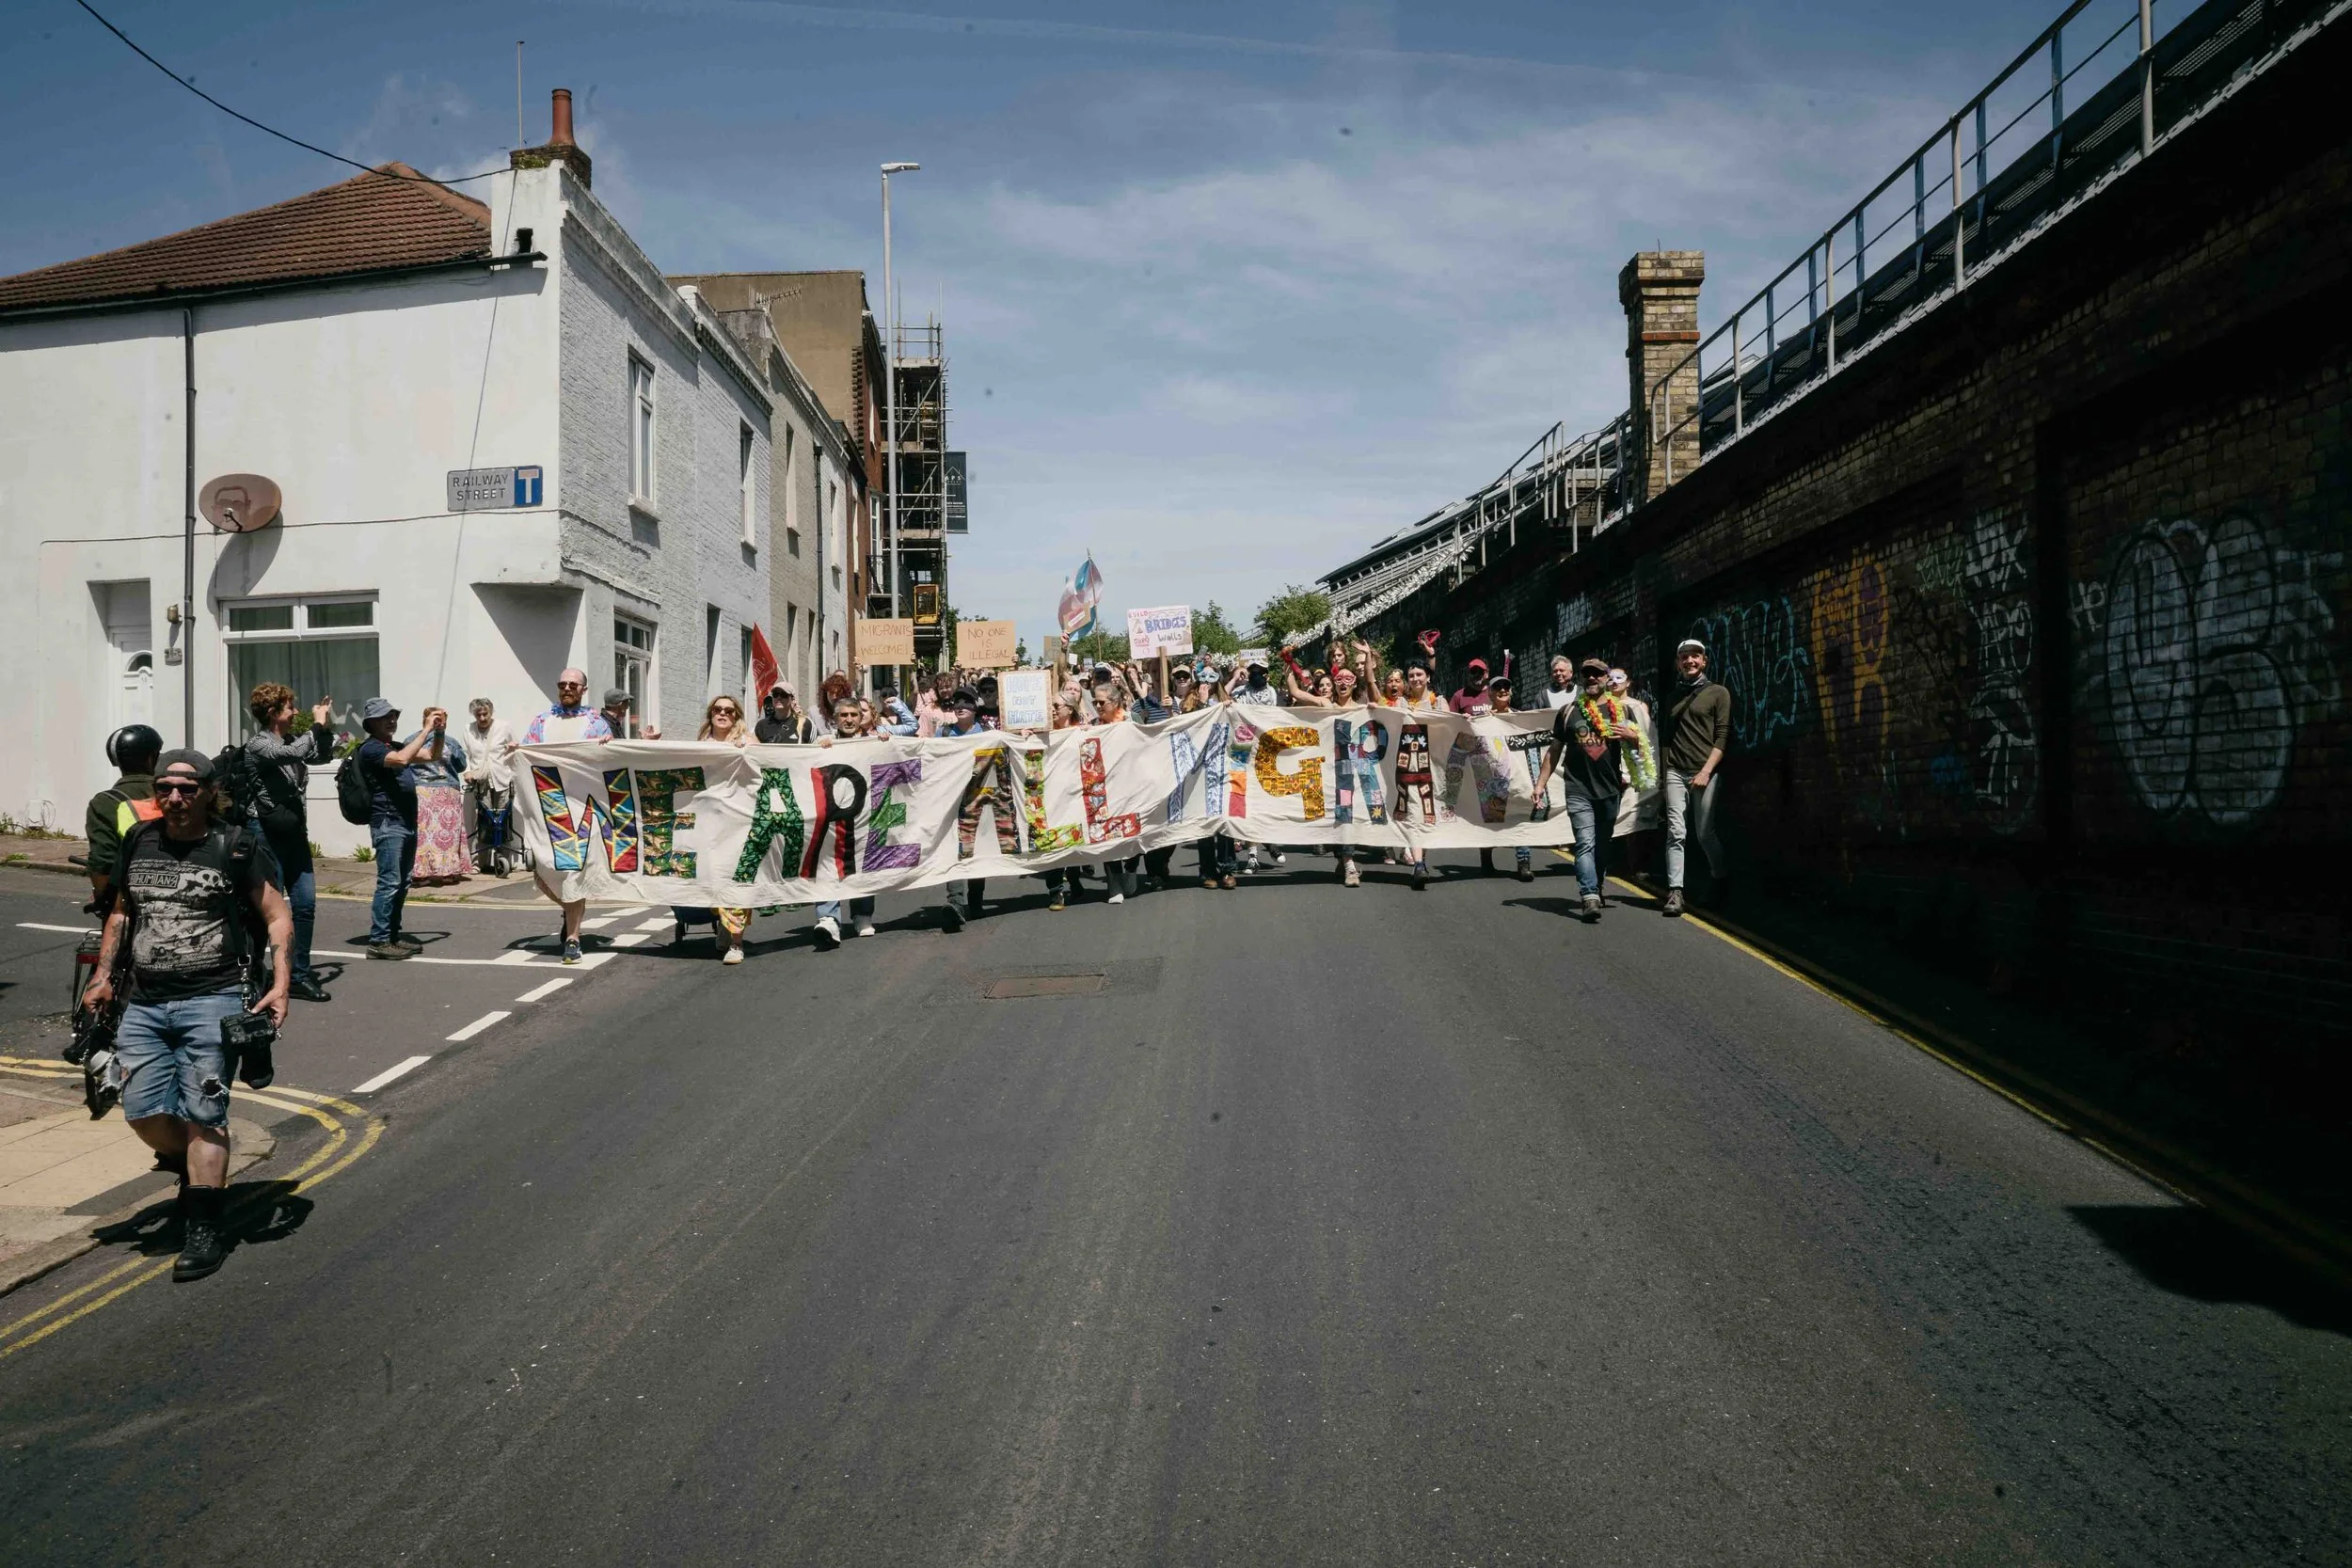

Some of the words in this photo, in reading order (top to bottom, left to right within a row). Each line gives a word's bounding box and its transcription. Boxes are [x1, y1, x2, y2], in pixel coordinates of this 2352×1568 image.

[453, 474, 509, 487] RAILWAY
[456, 488, 506, 501] STREET
[861, 625, 913, 637] MIGRANTS
[967, 627, 984, 640] NO
[988, 627, 1007, 637] ONE
[981, 639, 993, 648] IS
[969, 649, 1009, 660] ILLEGAL
[1007, 709, 1044, 725] HATE
[531, 765, 707, 879] WE
[732, 757, 922, 882] ARE
[958, 737, 1141, 861] ALL
